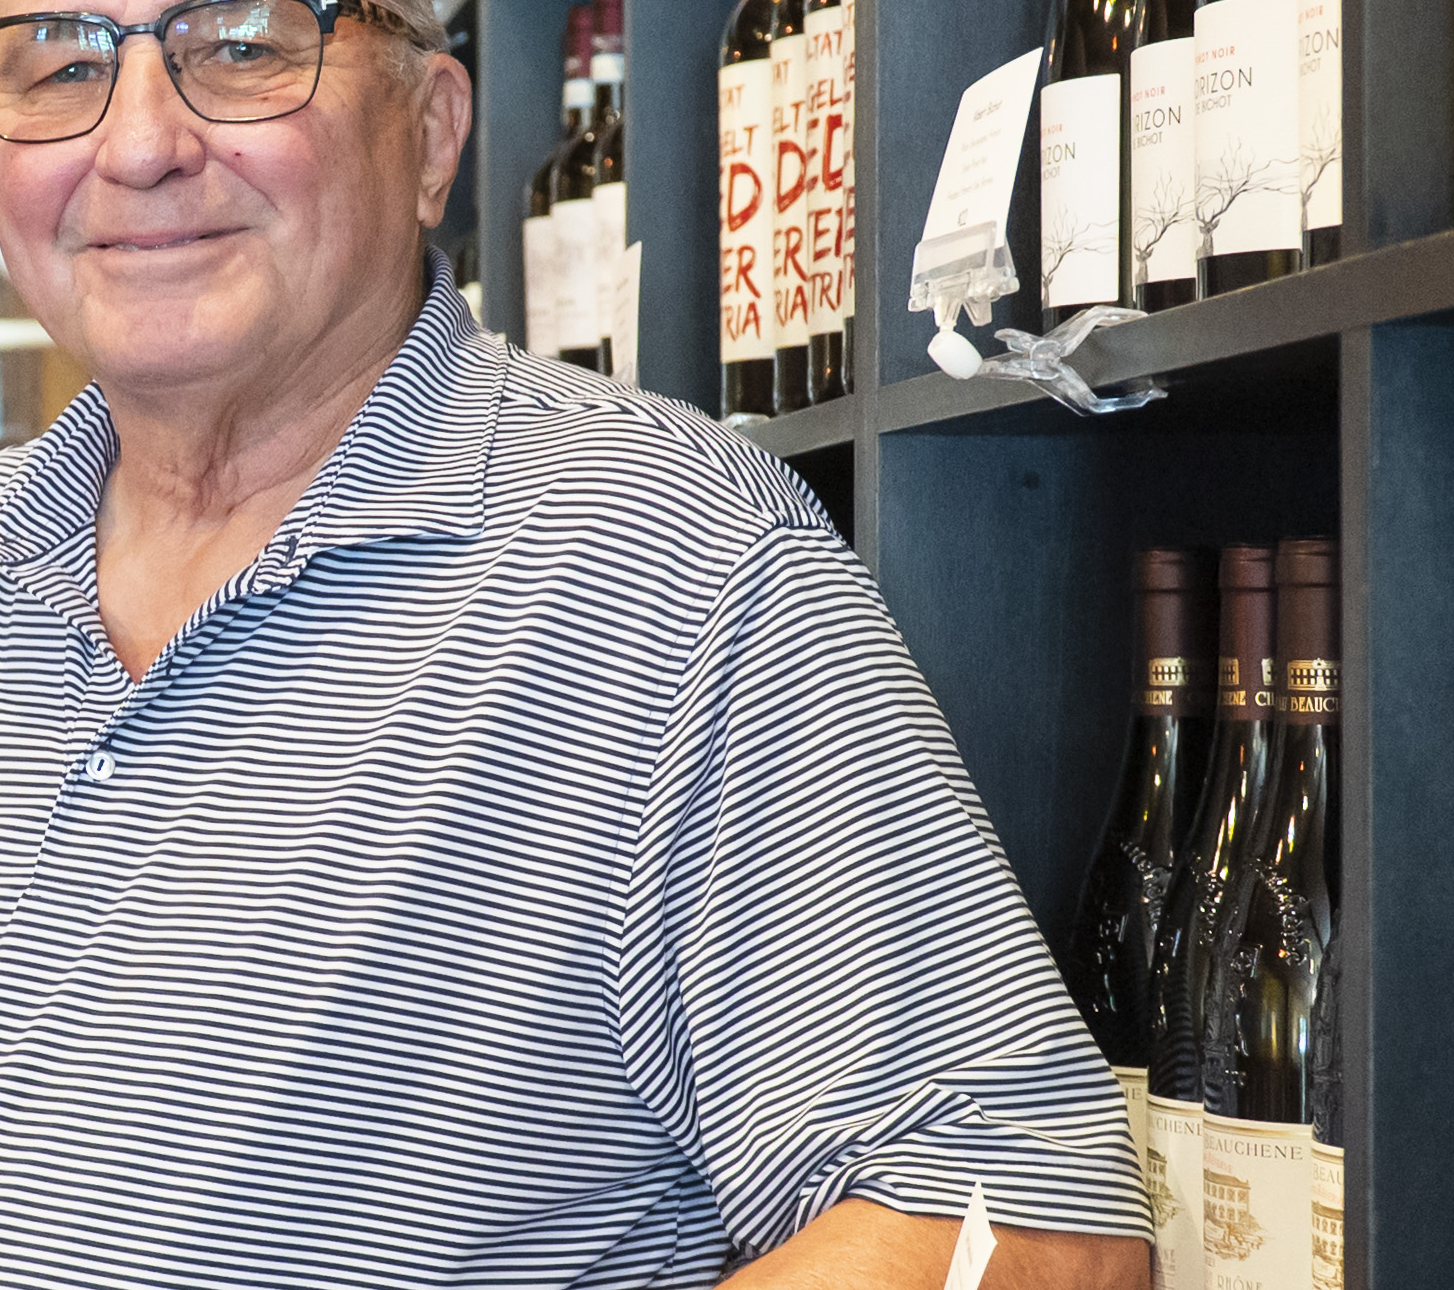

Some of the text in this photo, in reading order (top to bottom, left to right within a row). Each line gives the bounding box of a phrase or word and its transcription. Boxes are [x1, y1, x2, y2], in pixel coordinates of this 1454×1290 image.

[1212, 46, 1235, 59] NOIR
[1145, 85, 1166, 99] NOIR
[1204, 1133, 1303, 1161] BEAUCHENE
